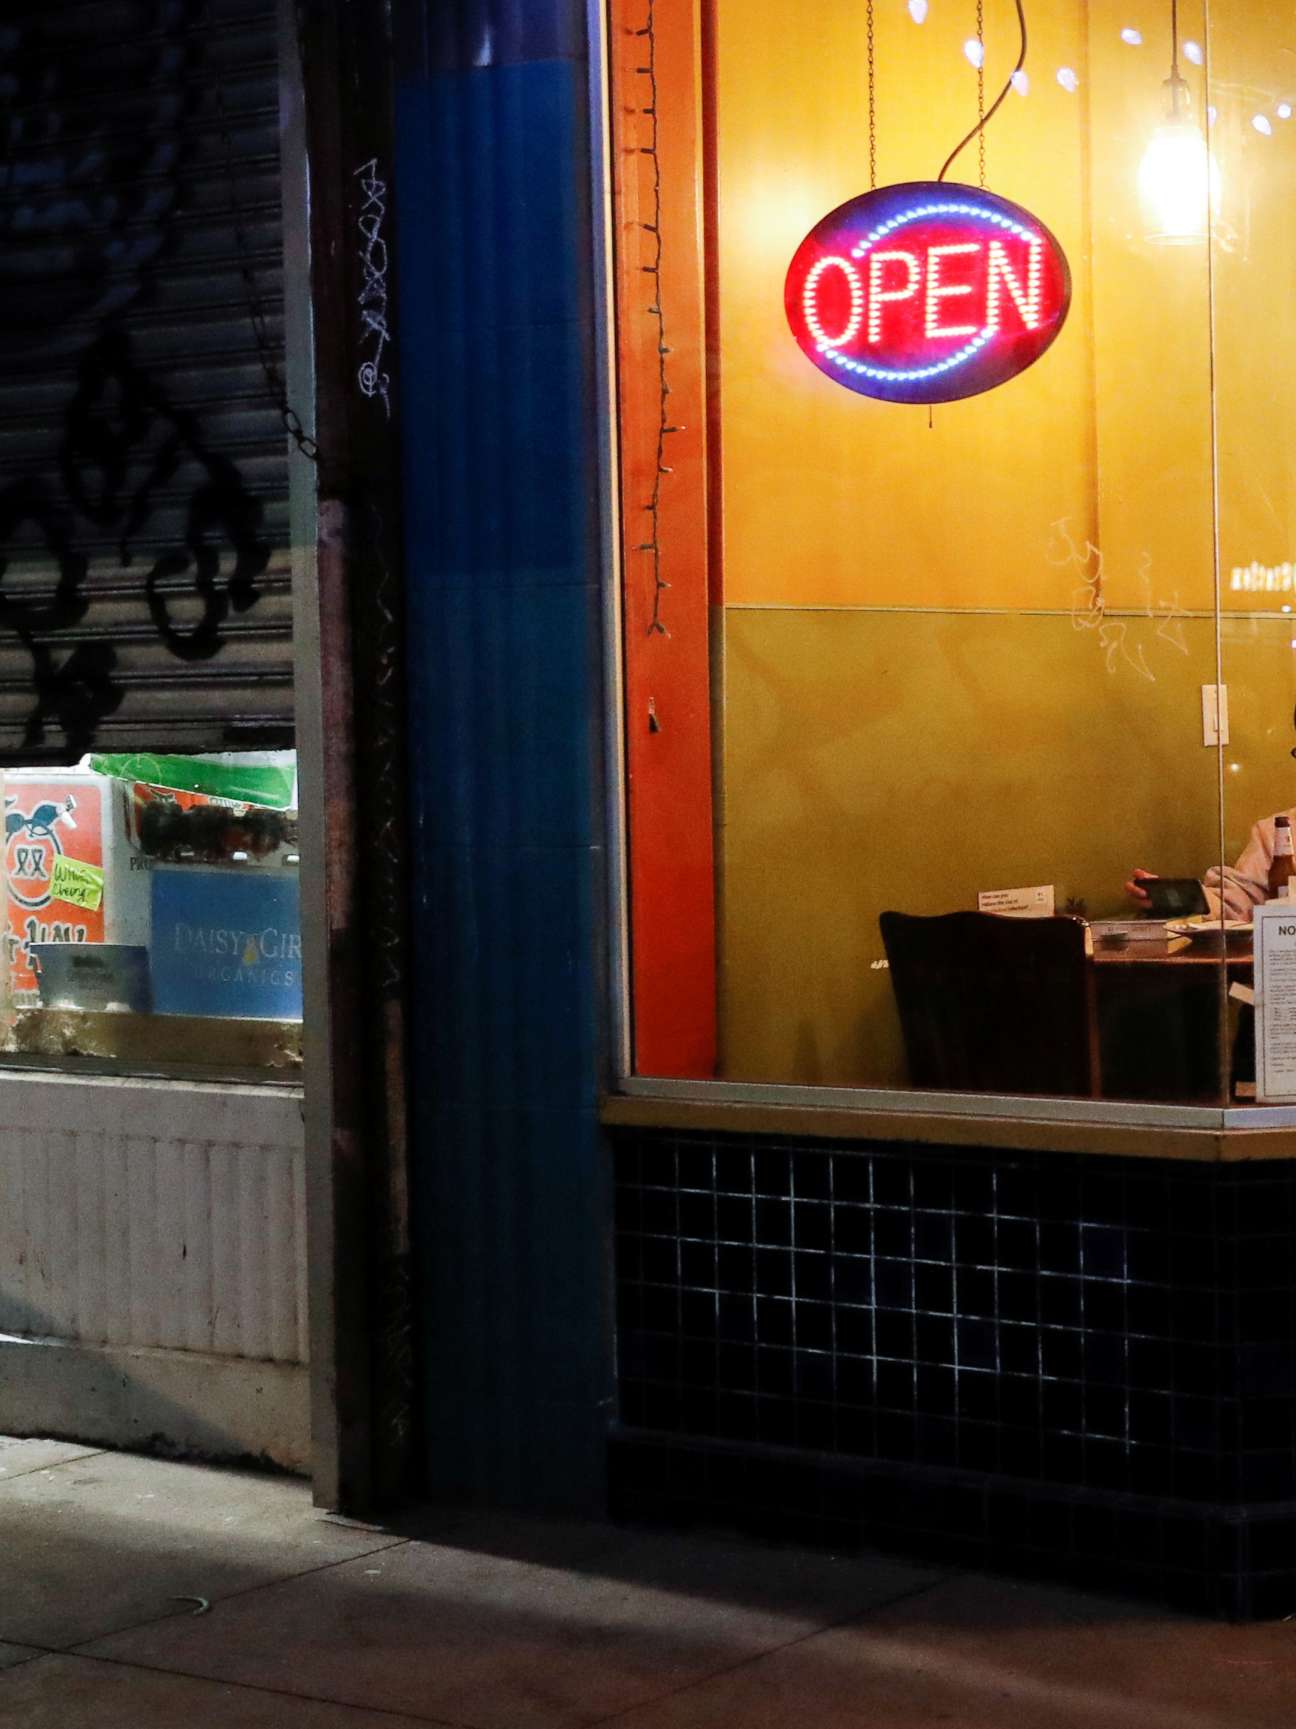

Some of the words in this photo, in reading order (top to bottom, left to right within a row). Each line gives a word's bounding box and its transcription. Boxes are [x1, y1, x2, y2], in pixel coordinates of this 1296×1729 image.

[803, 240, 1042, 348] OPEN
[175, 922, 244, 956] DAISY
[1278, 925, 1296, 936] NO
[191, 966, 296, 986] RGANICS
